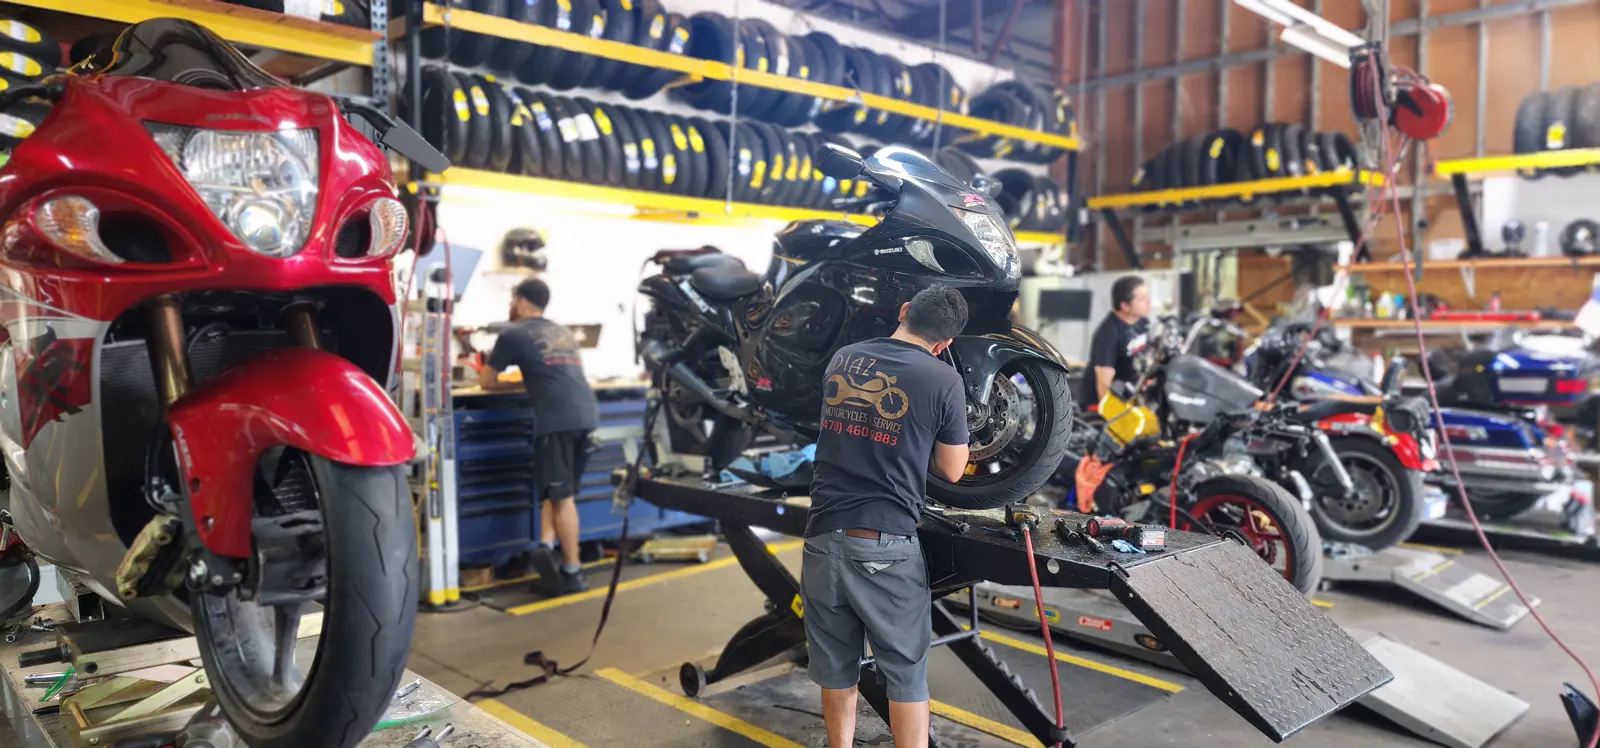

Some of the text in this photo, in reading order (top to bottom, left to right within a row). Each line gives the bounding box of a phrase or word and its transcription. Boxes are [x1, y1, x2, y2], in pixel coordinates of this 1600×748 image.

[832, 354, 877, 376] DIAZ
[825, 406, 903, 434] MOTORCYCLES SERVICE
